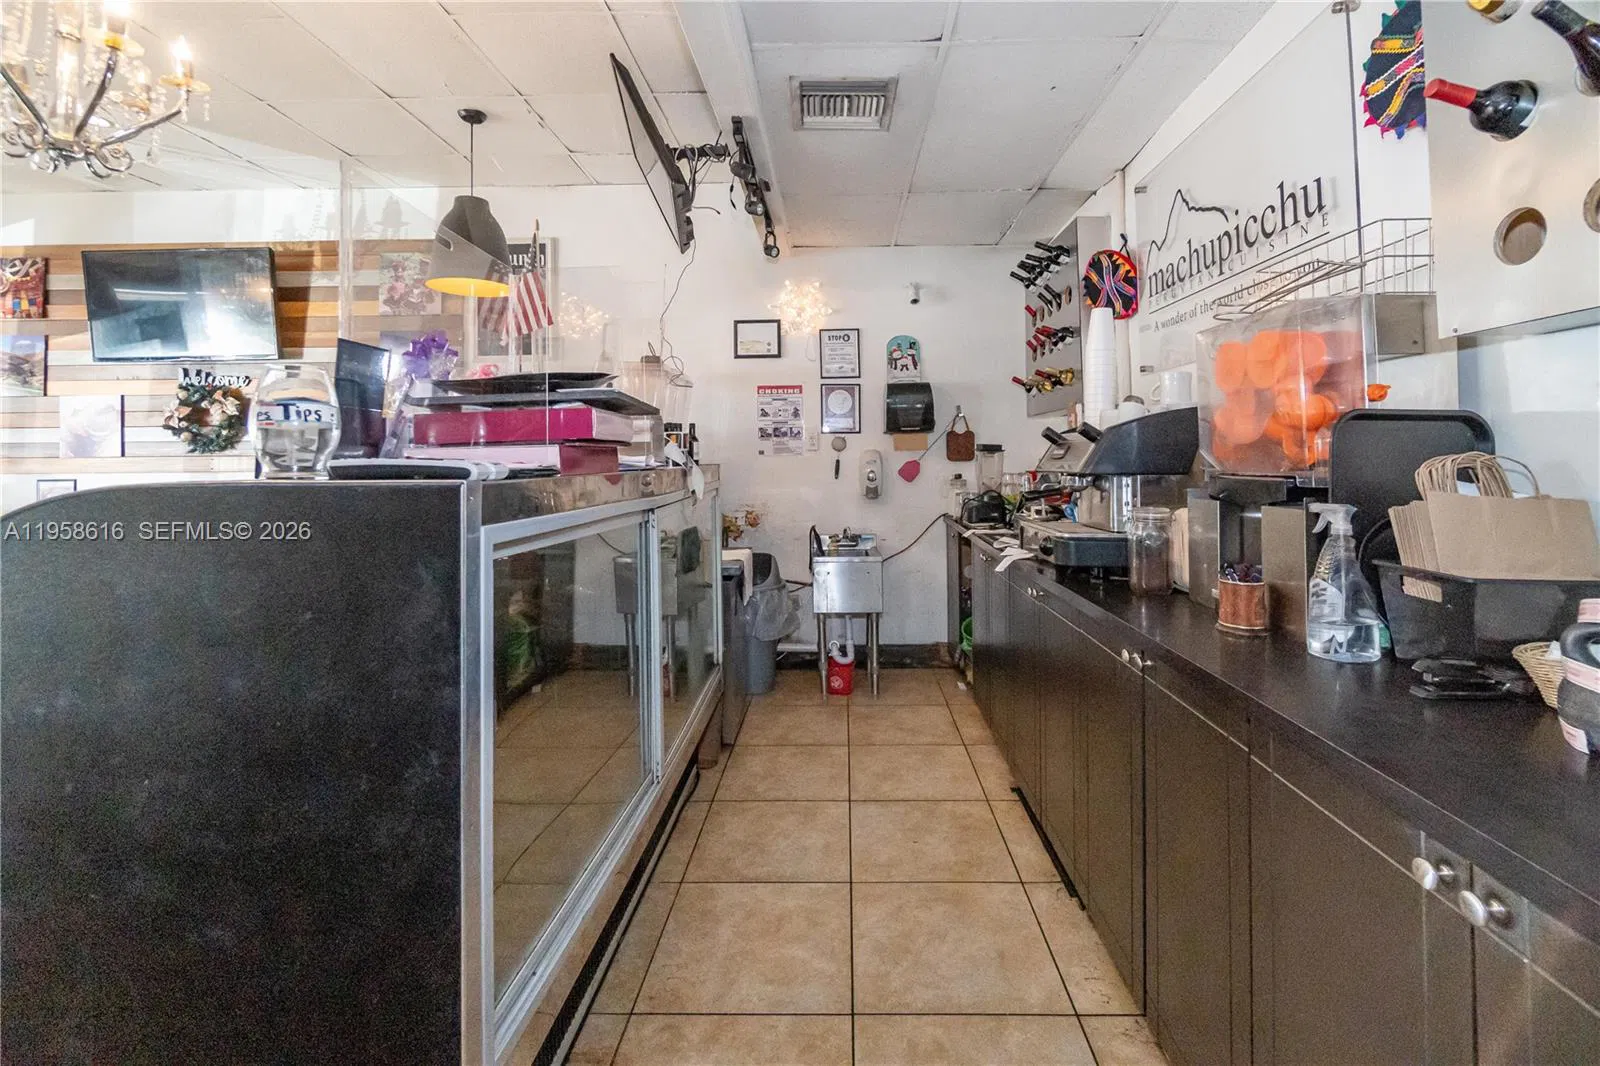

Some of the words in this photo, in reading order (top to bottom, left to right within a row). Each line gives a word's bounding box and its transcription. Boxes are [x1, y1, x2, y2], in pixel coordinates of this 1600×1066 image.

[1148, 176, 1326, 298] machupicchu
[1227, 212, 1329, 271] CUISINE
[1154, 320, 1160, 333] A
[1160, 311, 1188, 330] wonder
[1189, 302, 1199, 319] of
[1199, 299, 1214, 315] the
